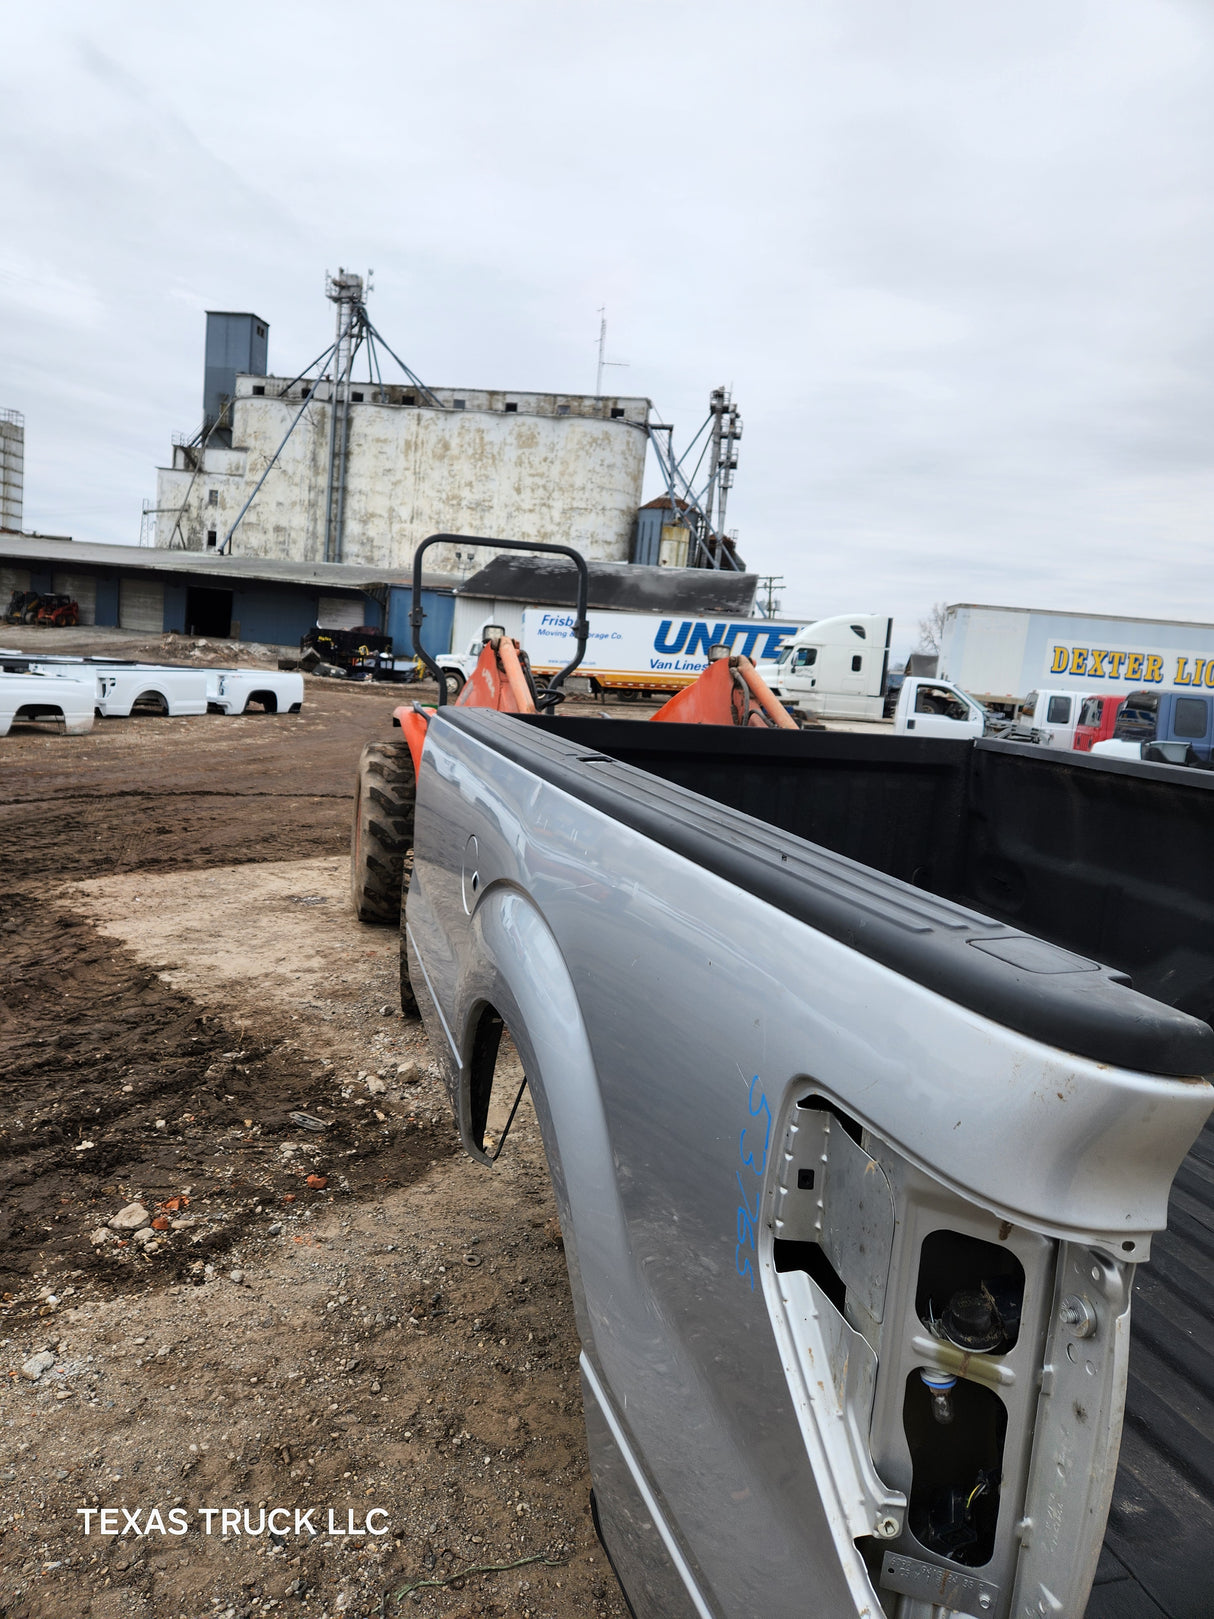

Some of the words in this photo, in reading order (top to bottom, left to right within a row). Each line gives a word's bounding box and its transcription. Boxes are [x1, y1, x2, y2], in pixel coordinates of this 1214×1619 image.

[541, 614, 574, 627] Frisb
[537, 629, 568, 638] Moving
[653, 620, 805, 660] UNITE
[650, 658, 672, 670] Van
[674, 660, 709, 672] Lines
[1050, 646, 1164, 683] DEXTER
